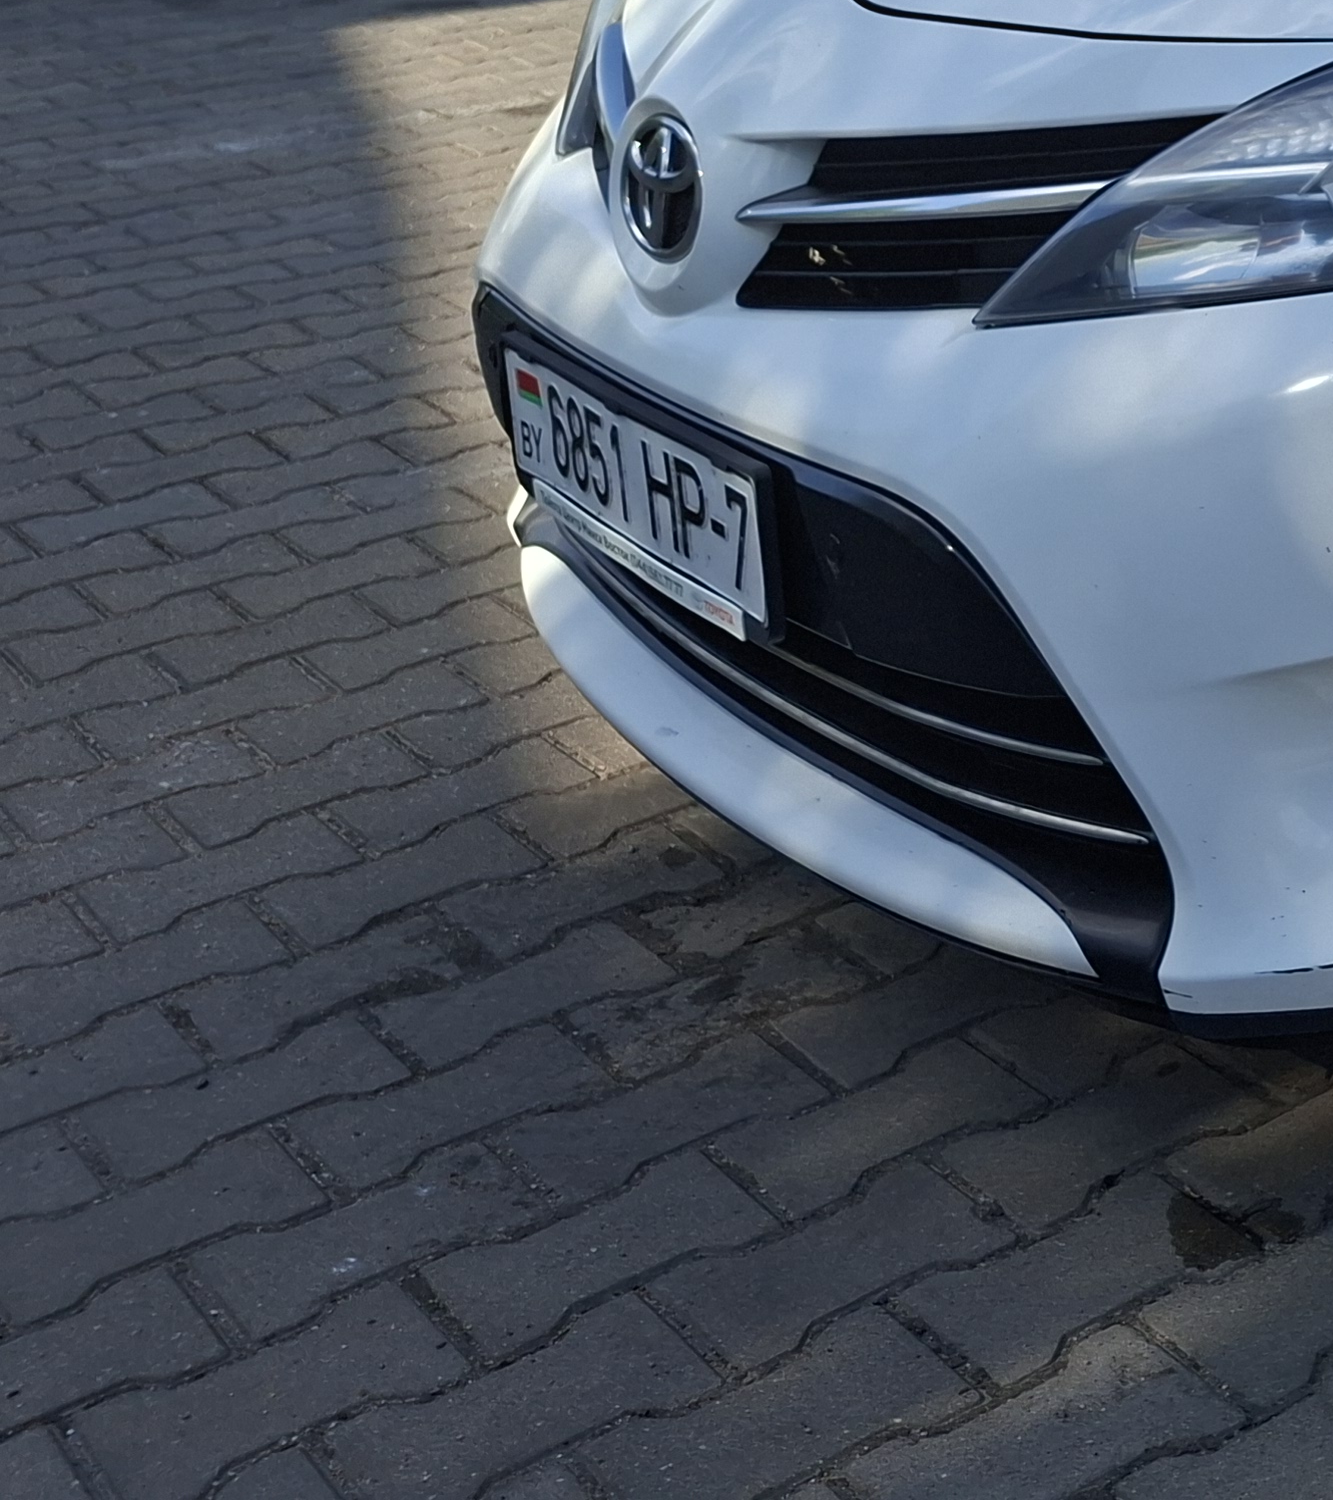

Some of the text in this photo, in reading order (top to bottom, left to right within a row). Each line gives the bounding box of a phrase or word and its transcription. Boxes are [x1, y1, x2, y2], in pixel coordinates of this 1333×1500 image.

[520, 420, 543, 463] BY
[547, 385, 748, 591] 6851 HP-7
